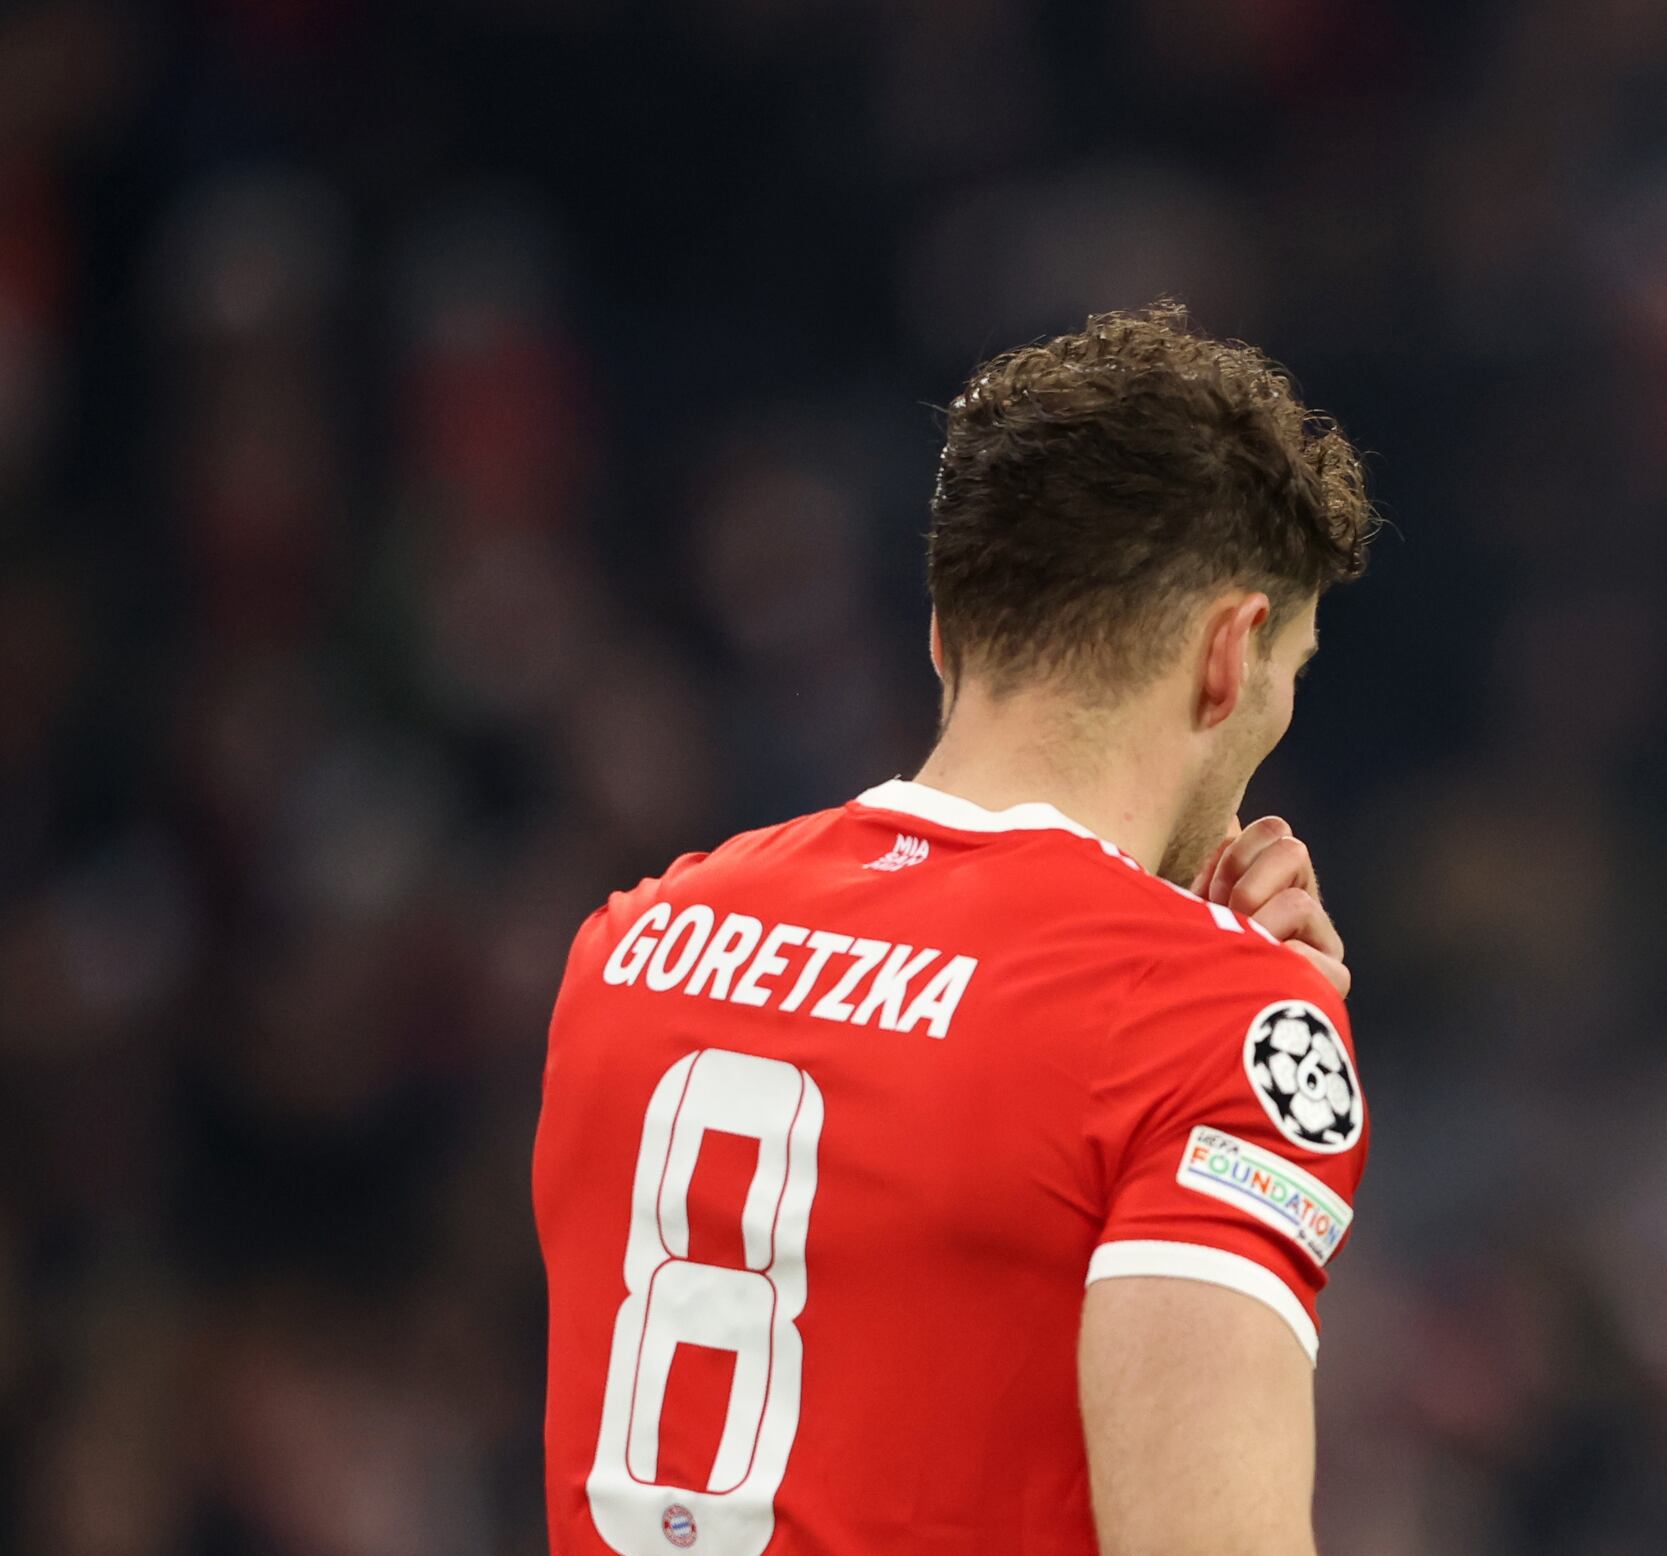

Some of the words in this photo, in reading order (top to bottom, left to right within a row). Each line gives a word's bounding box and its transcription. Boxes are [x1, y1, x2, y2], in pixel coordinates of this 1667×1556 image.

[603, 902, 978, 1040] GORETZKA
[1297, 1050, 1328, 1101] 6
[1191, 1146, 1340, 1246] FOUNDATION
